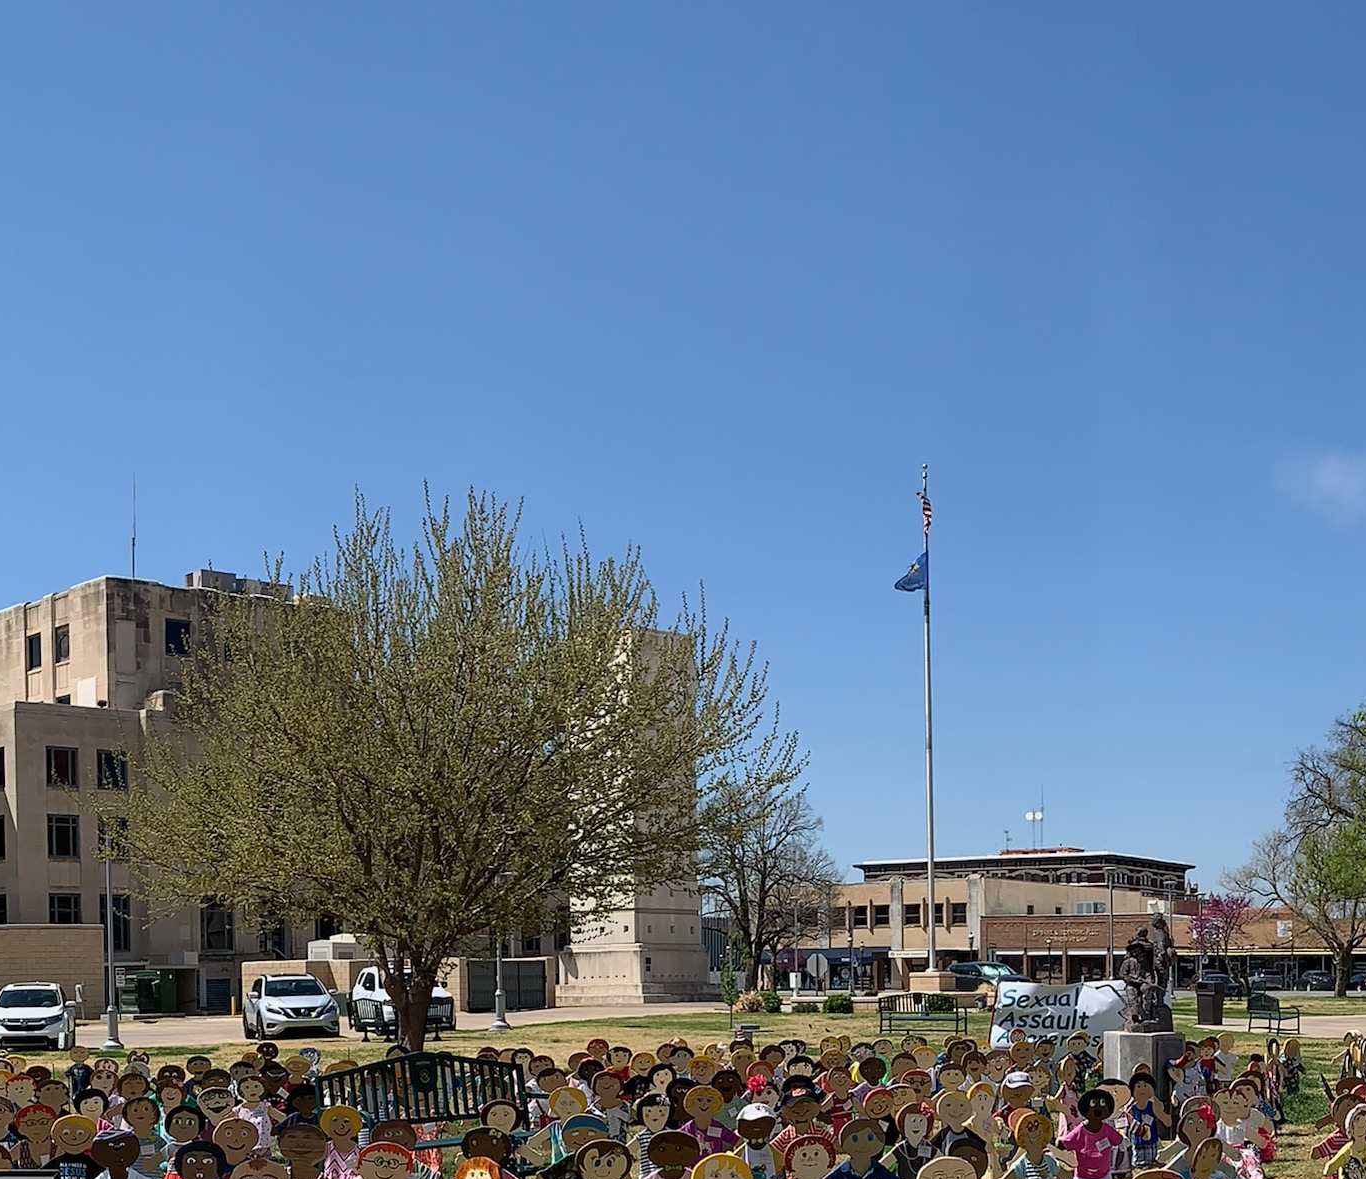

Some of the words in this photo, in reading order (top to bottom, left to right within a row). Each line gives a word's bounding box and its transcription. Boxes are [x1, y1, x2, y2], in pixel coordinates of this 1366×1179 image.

[1001, 988, 1079, 1009] Sexual
[998, 1010, 1089, 1030] Assault
[60, 1167, 87, 1176] JESUS
